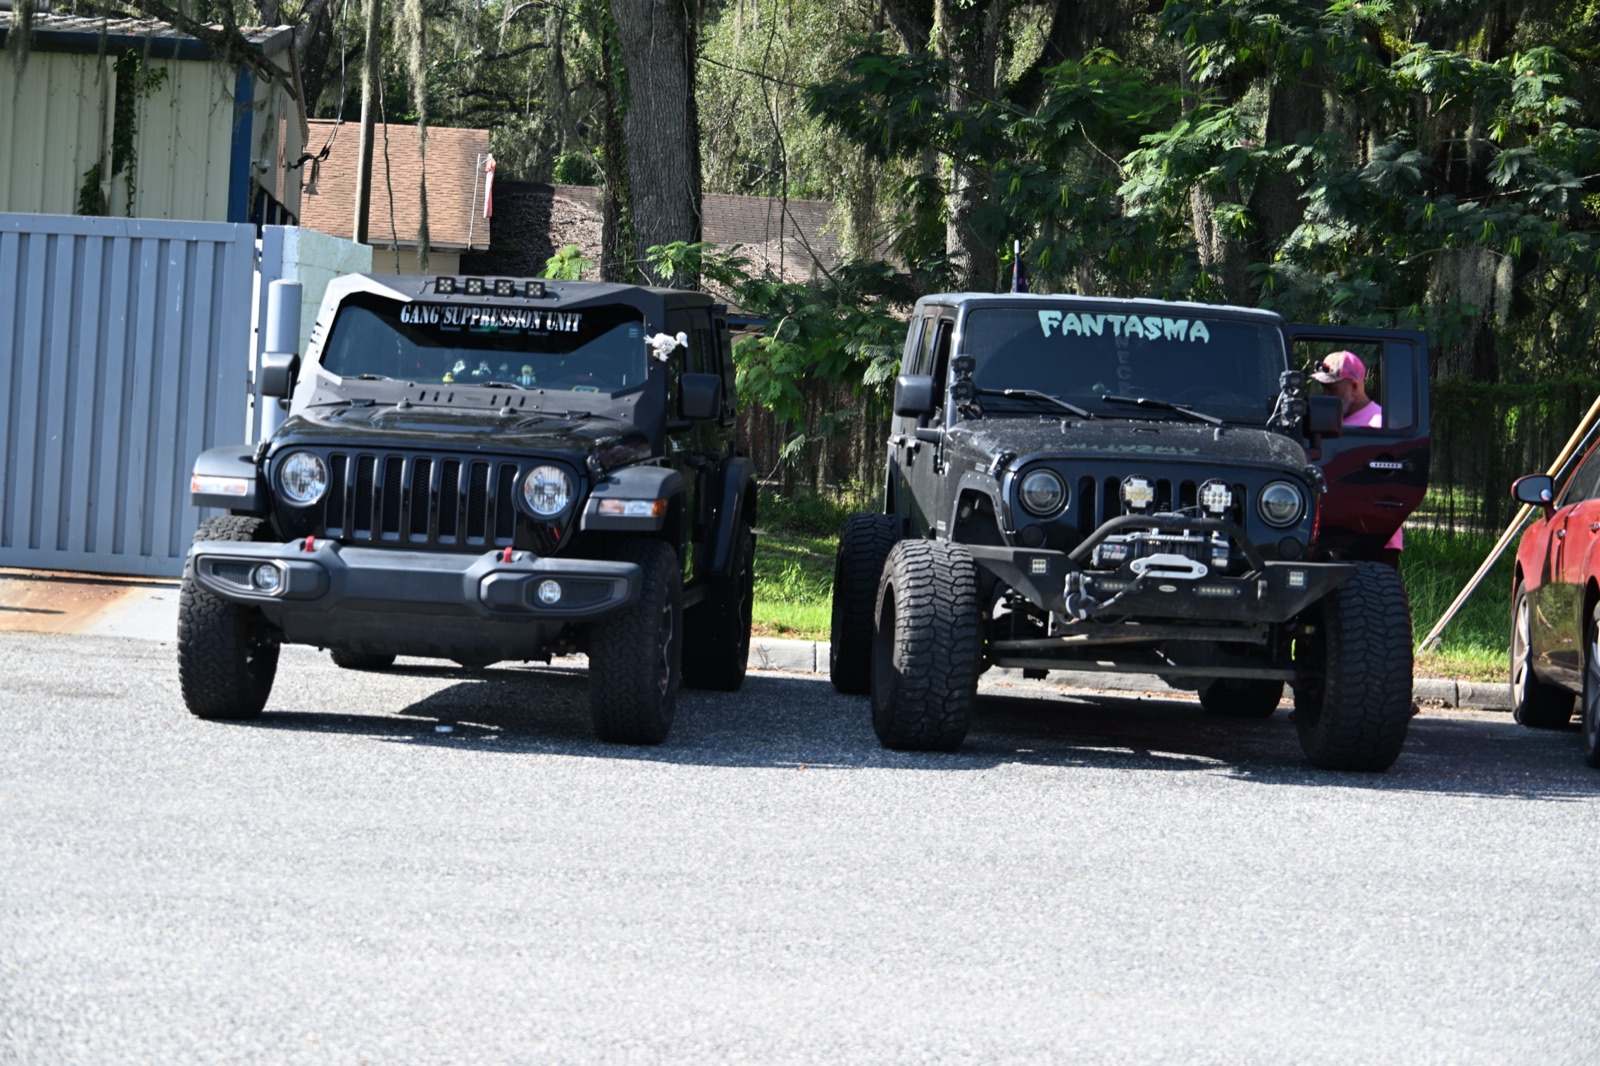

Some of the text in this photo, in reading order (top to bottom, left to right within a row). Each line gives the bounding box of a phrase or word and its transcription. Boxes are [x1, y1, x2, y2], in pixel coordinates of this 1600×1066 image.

[400, 304, 583, 333] GANG SUPPRESSION UNIT
[1038, 310, 1209, 344] FANTASMA
